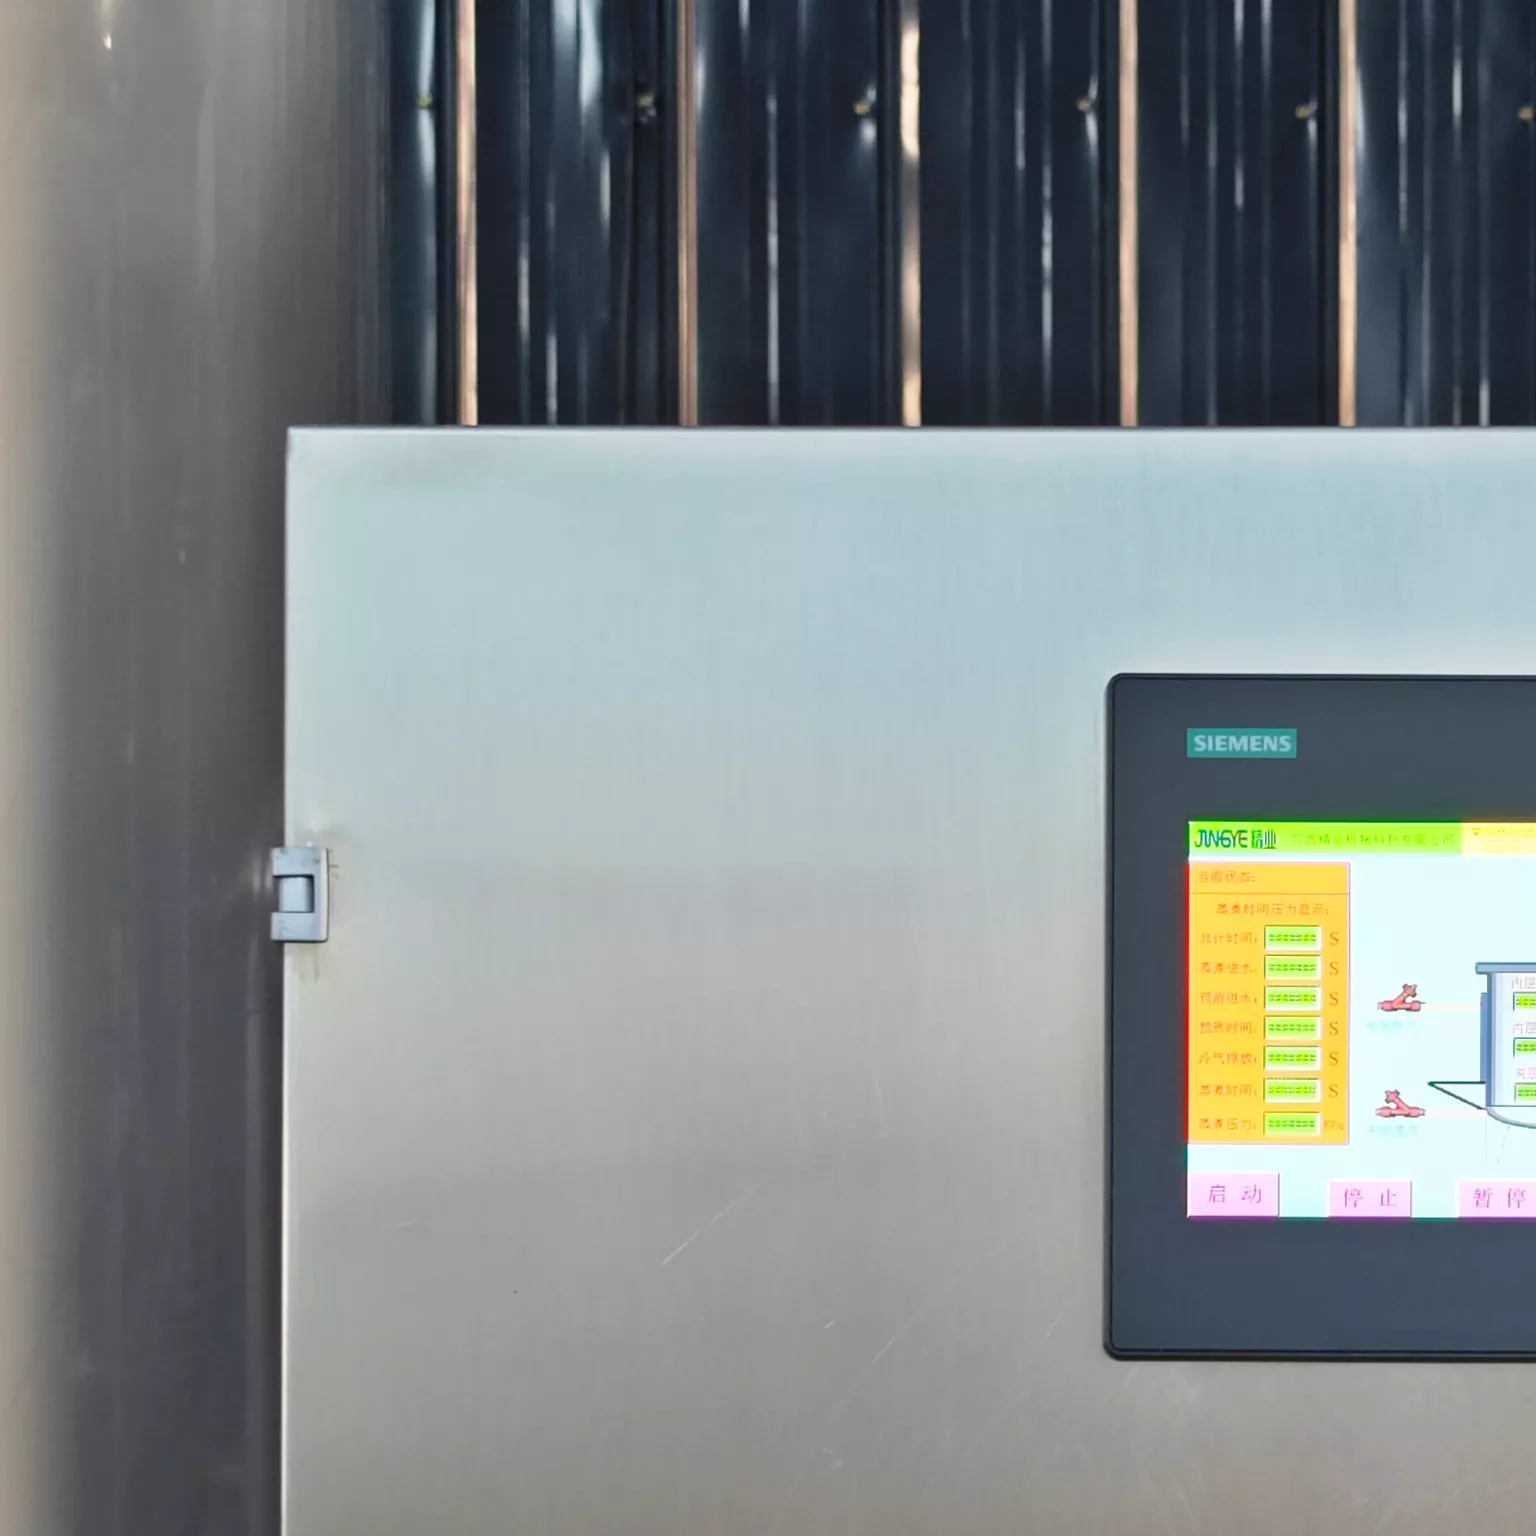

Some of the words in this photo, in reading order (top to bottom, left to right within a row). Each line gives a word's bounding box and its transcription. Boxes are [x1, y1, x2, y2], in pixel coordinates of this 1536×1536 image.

[1193, 734, 1292, 752] SIEMENS
[1194, 829, 1248, 848] JINGYE
[1329, 931, 1340, 946] S
[1329, 961, 1340, 976] S
[1329, 991, 1340, 1006] S
[1329, 1021, 1340, 1036] S
[1329, 1051, 1340, 1066] S
[1329, 1083, 1340, 1098] S
[1207, 1183, 1262, 1205] 启动
[1342, 1187, 1397, 1209] 停止
[1472, 1186, 1527, 1209] 暂停
